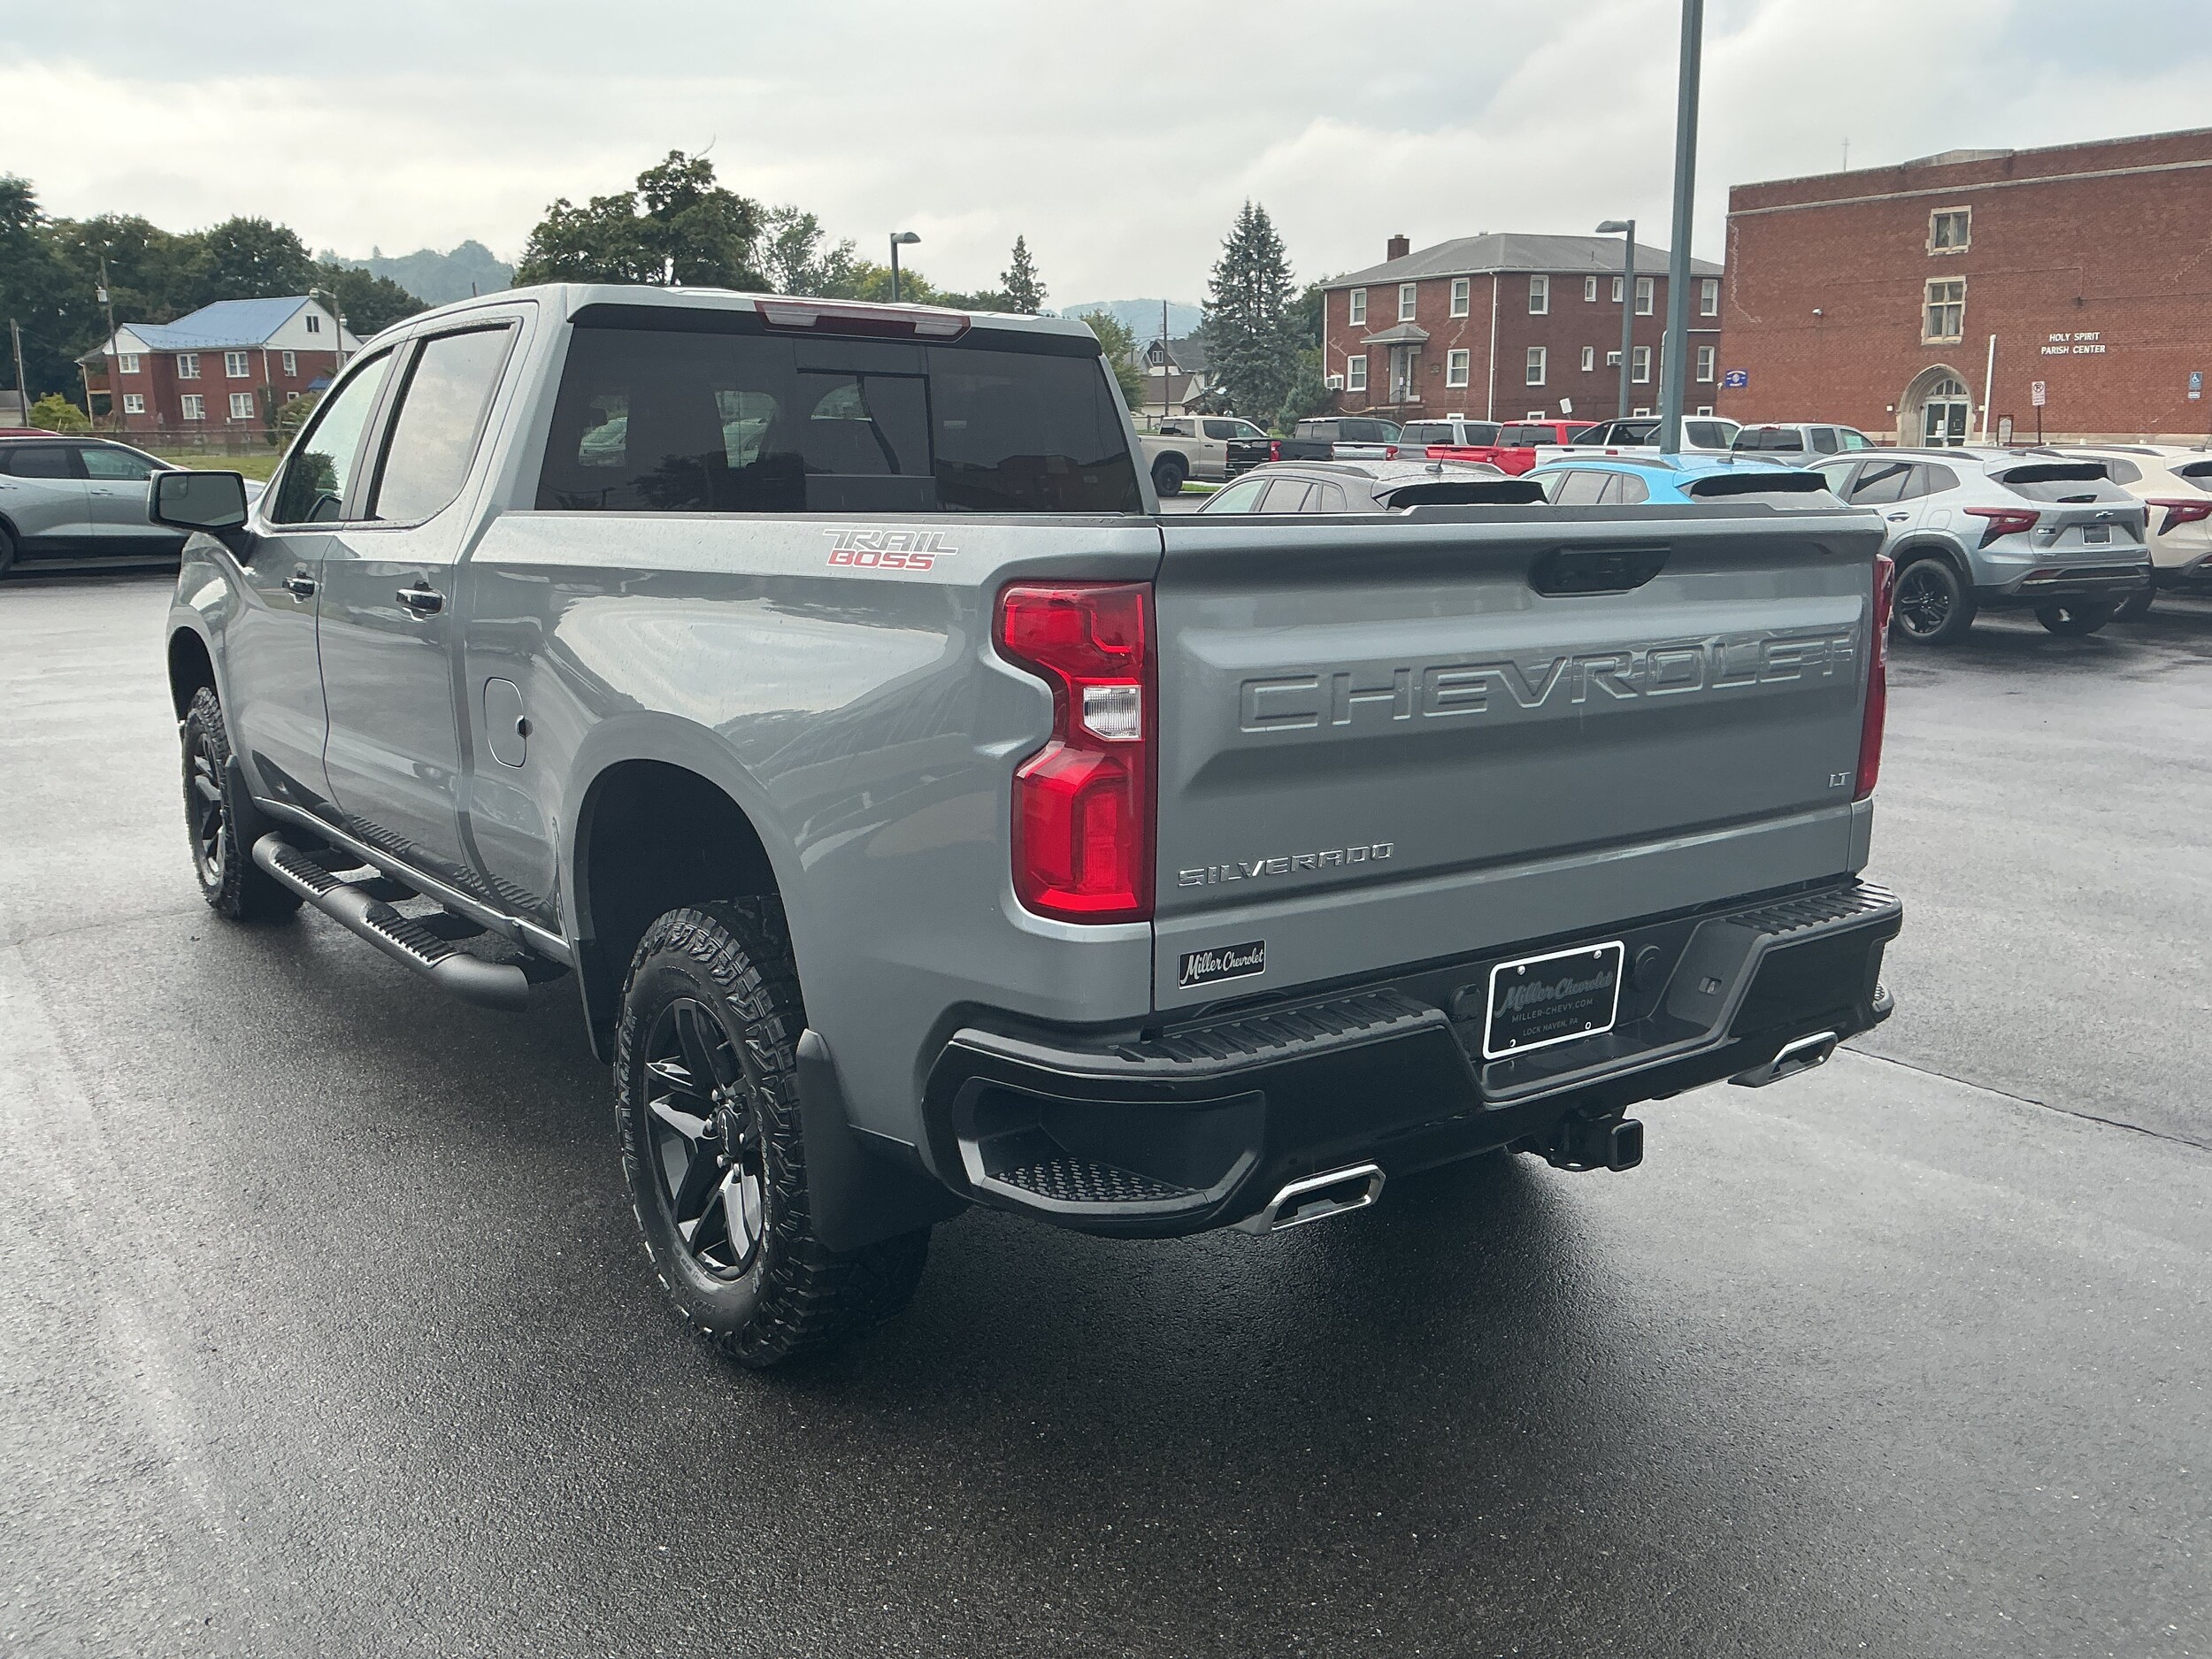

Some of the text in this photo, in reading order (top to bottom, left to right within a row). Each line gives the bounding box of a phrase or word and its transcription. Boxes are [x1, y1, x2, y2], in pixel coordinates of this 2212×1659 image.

[2040, 344, 2106, 355] PARISH CENTER
[2049, 332, 2101, 342] HOLY SPIRIT
[822, 529, 959, 556] TRAIL
[826, 549, 938, 572] BOSS
[1240, 631, 1852, 733] CHEVROLET
[1829, 772, 1851, 787] LT
[1178, 841, 1394, 887] SILVERADO
[1180, 947, 1264, 985] Miller Chevrolet
[1494, 971, 1613, 1018] Miller Chevrolet
[1511, 998, 1594, 1023] MILLER-CHEVY.COM
[1523, 1026, 1541, 1036] LOCK
